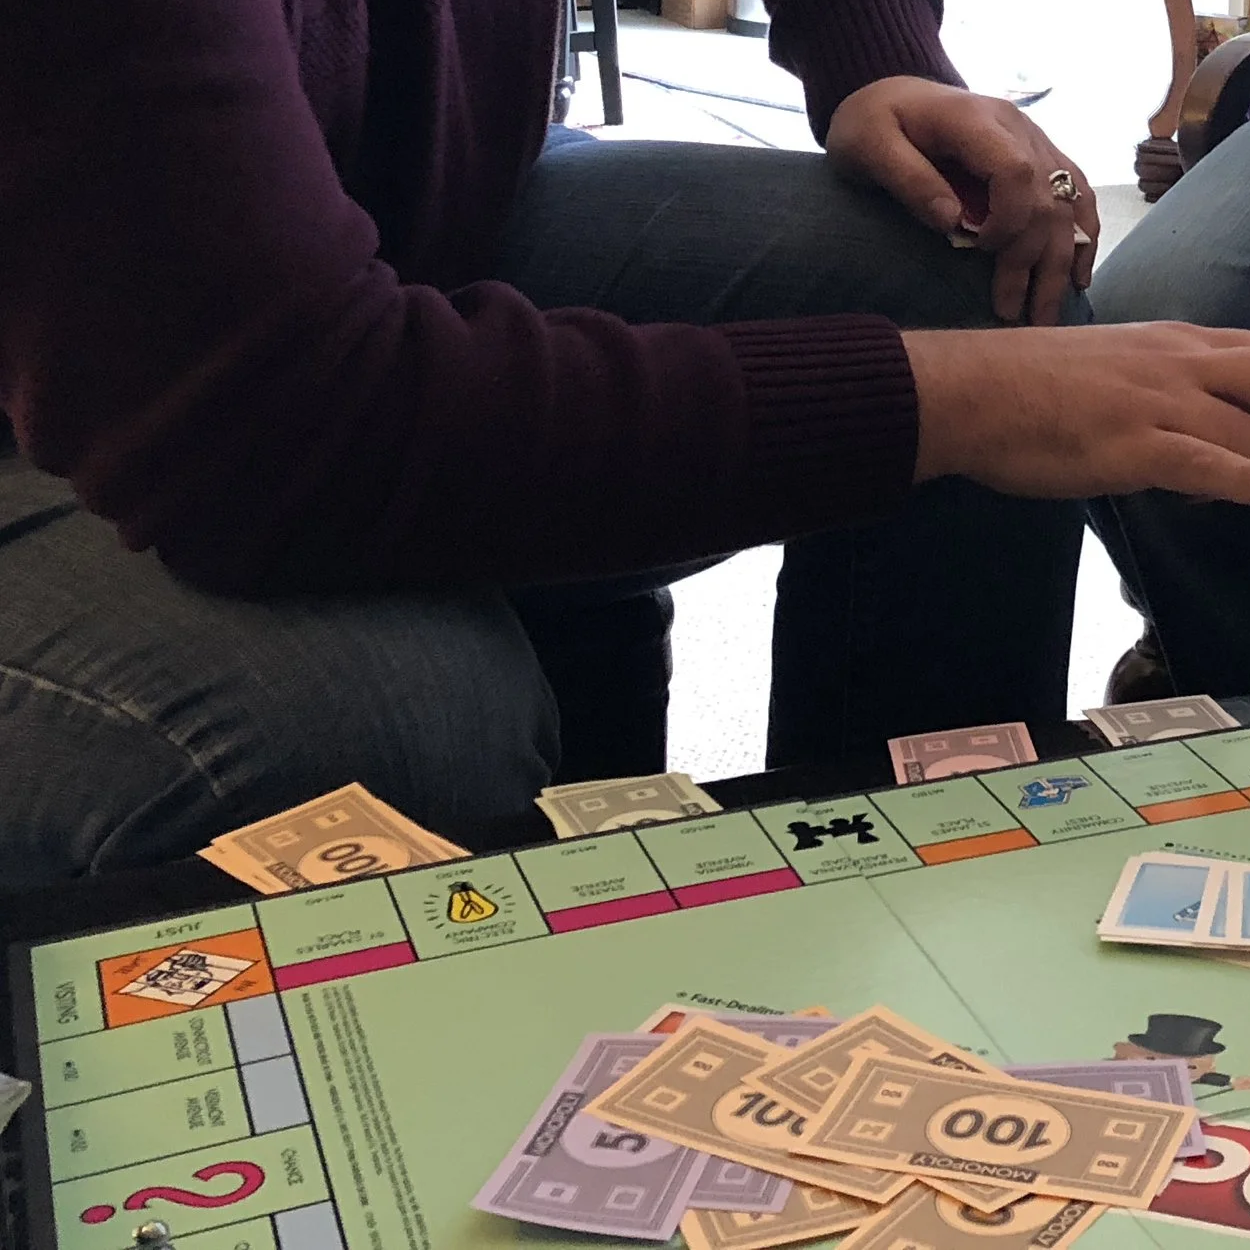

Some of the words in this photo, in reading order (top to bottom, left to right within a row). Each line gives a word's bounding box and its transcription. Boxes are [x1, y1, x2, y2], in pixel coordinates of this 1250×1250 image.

[1052, 817, 1124, 834] COMMUNITY
[1064, 814, 1101, 825] CHEST
[154, 921, 204, 940] JUST
[944, 1107, 1054, 1153] 100
[911, 1153, 1035, 1183] MONOPOLY
